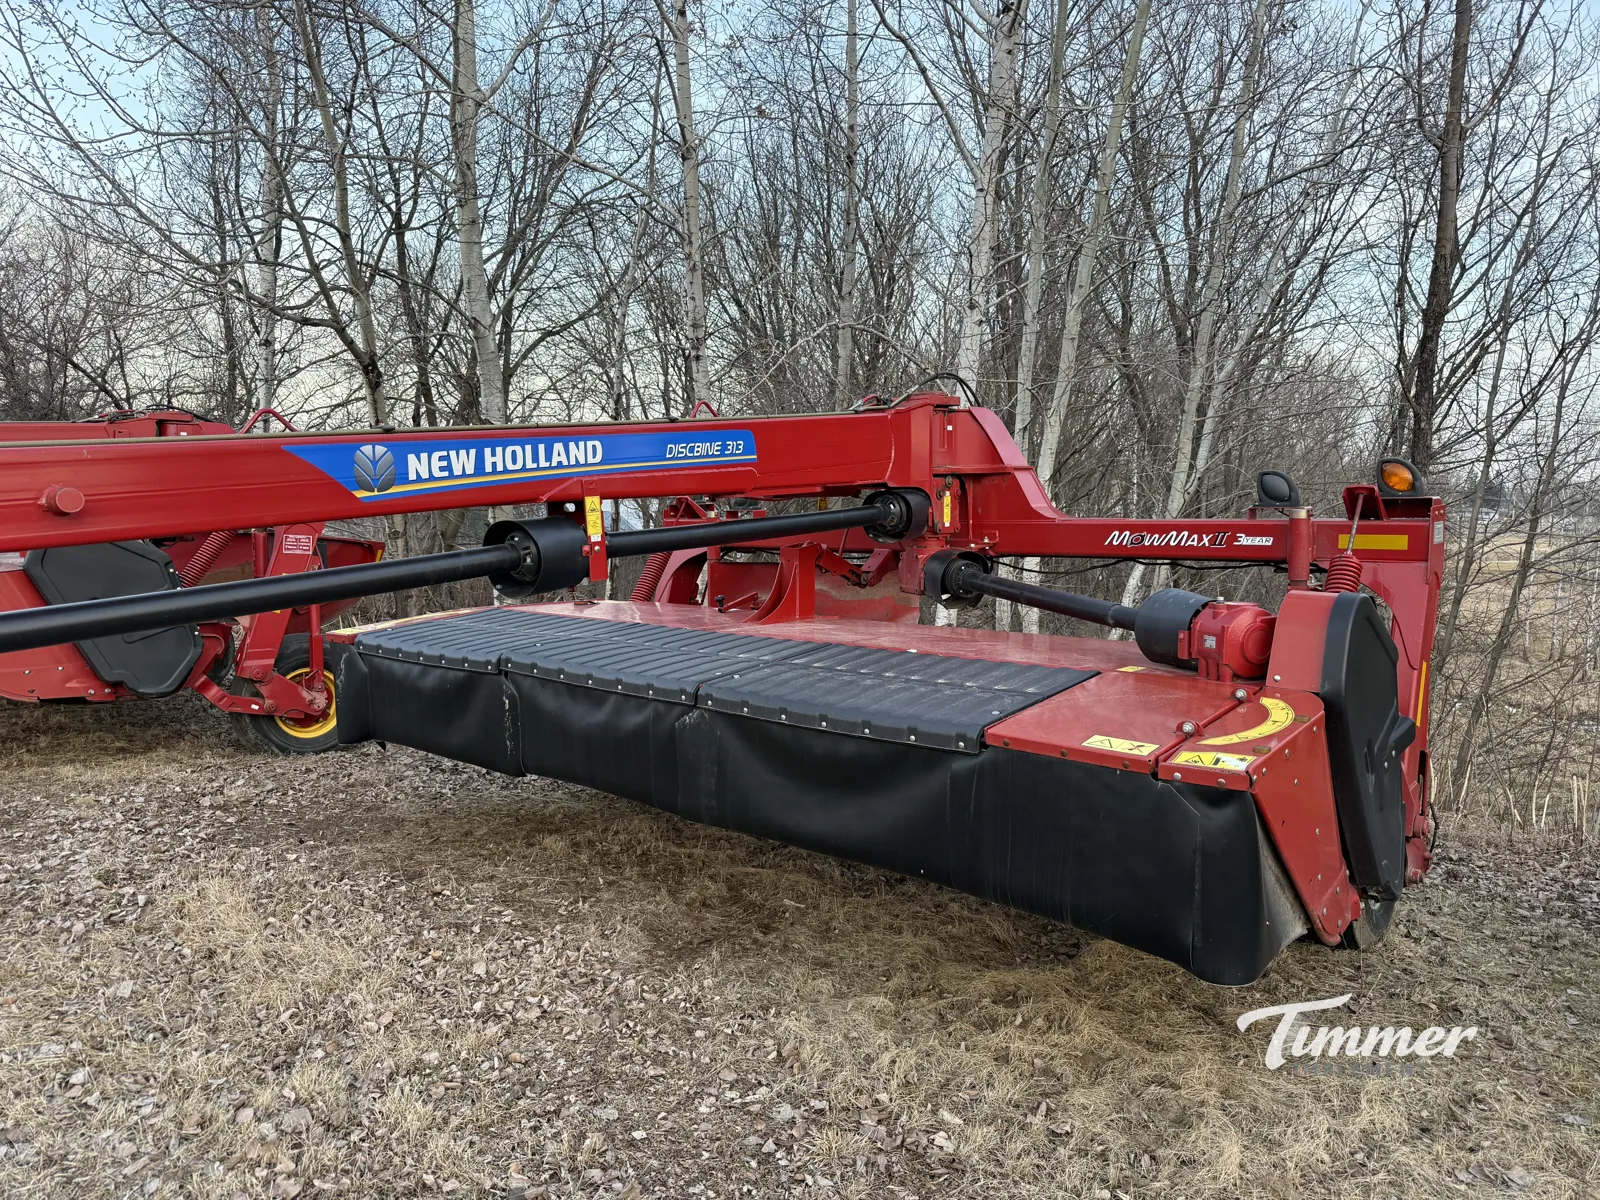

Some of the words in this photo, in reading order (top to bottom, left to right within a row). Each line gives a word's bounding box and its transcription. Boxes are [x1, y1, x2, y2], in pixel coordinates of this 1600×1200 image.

[407, 449, 476, 481] NEW
[484, 440, 603, 473] HOLLAND
[666, 442, 722, 458] DISCBINE
[725, 440, 744, 454] 313
